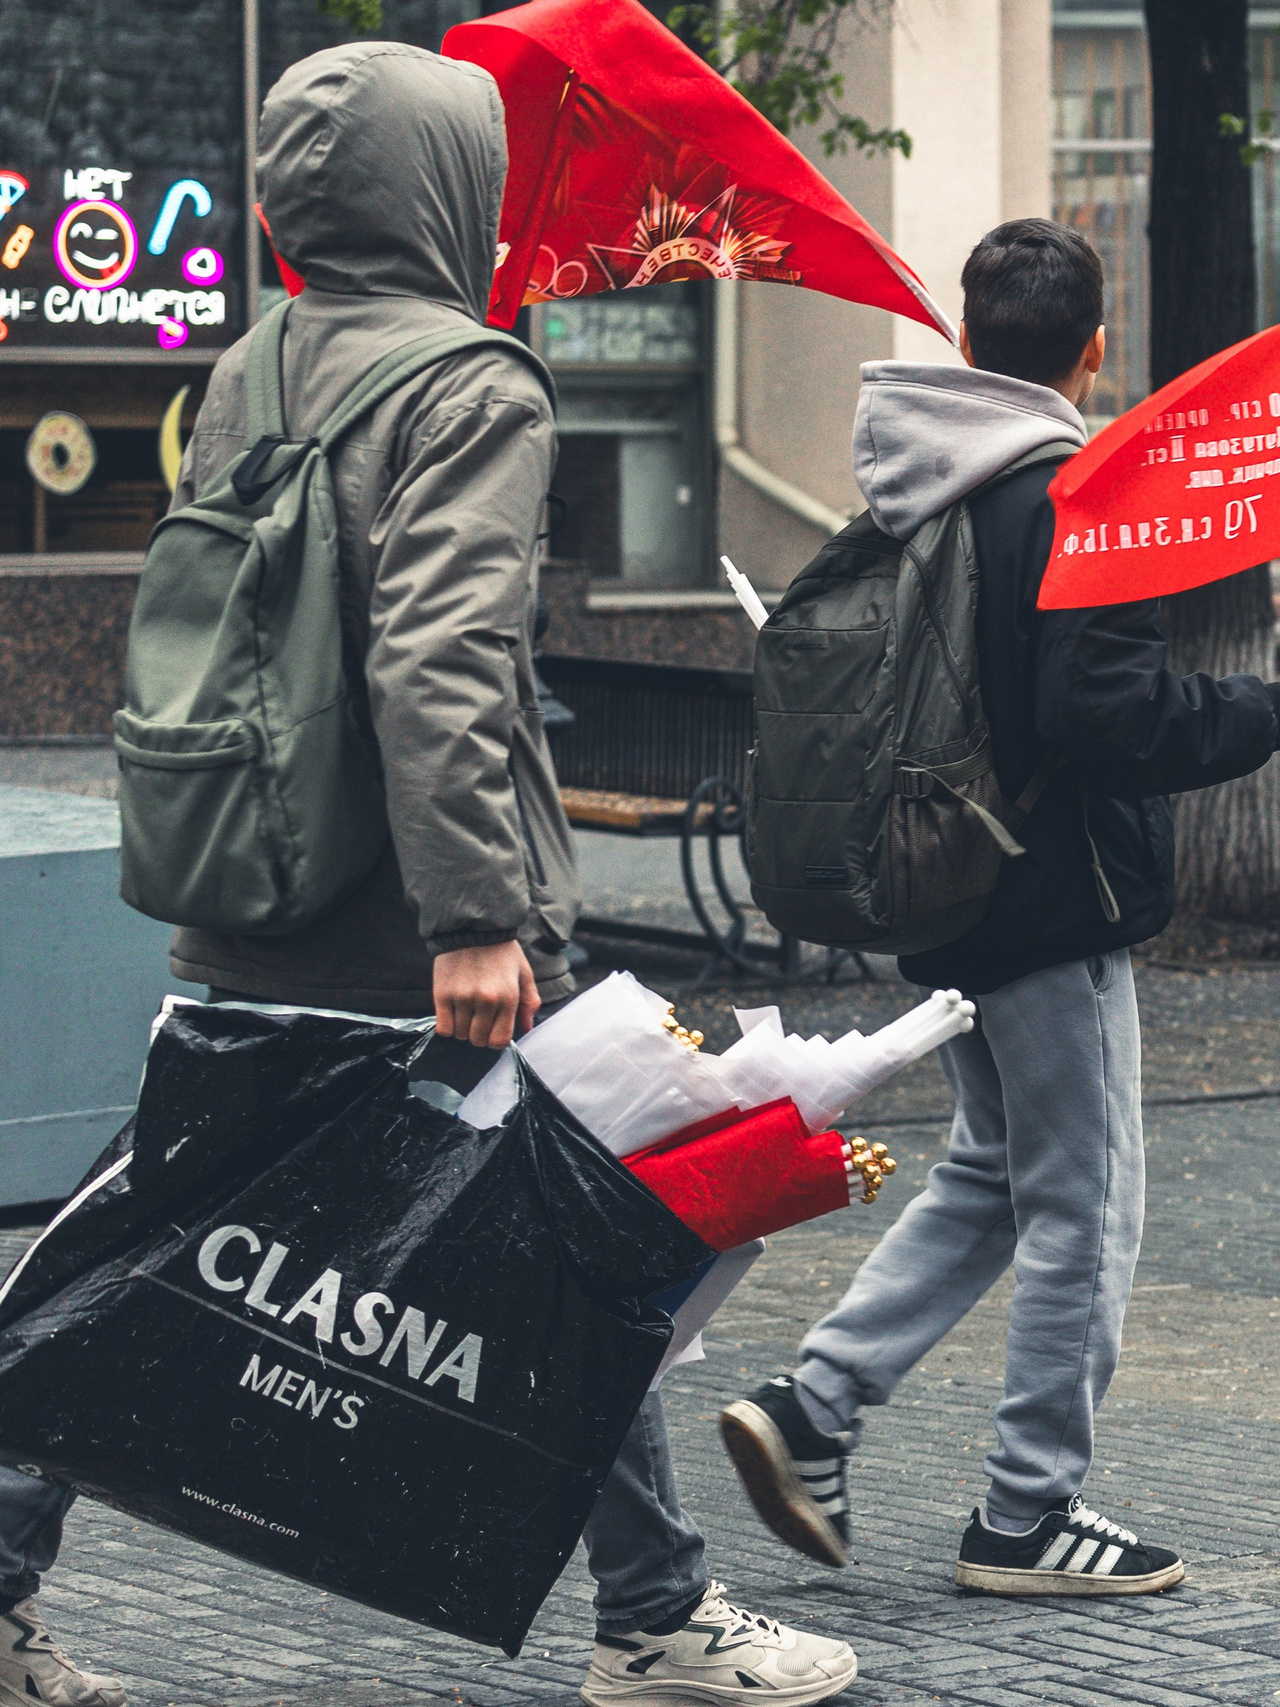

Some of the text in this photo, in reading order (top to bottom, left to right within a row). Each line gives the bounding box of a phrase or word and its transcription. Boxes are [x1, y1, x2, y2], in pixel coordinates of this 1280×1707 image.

[63, 167, 133, 201] НЕТ
[197, 1224, 484, 1404] CLASNA
[238, 1353, 366, 1430] MEN'S
[181, 1485, 301, 1539] www.clasna.com
